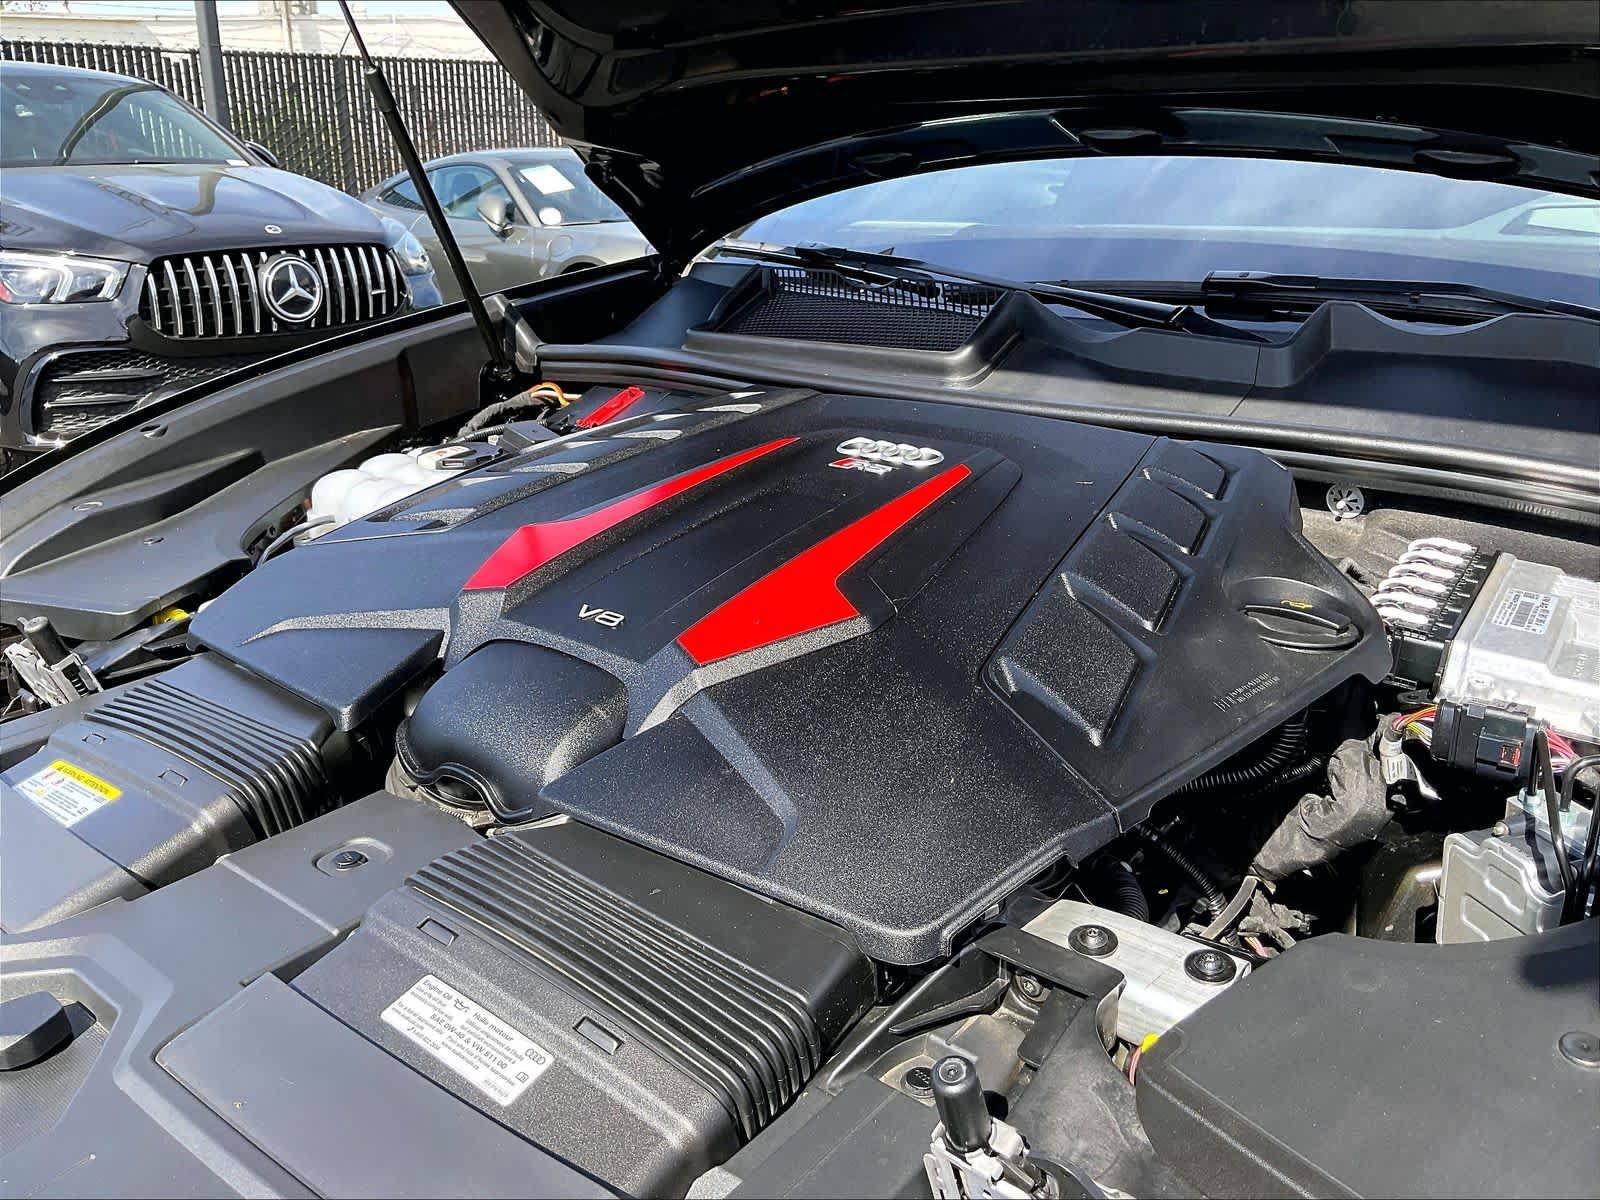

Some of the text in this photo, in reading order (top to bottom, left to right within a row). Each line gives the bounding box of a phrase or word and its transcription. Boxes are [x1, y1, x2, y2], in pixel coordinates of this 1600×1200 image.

[578, 604, 625, 627] V8
[423, 980, 443, 995] Engine
[442, 991, 454, 1001] Oil
[430, 1013, 444, 1026] SAE
[471, 1041, 485, 1053] VW
[488, 1024, 513, 1042] moteur
